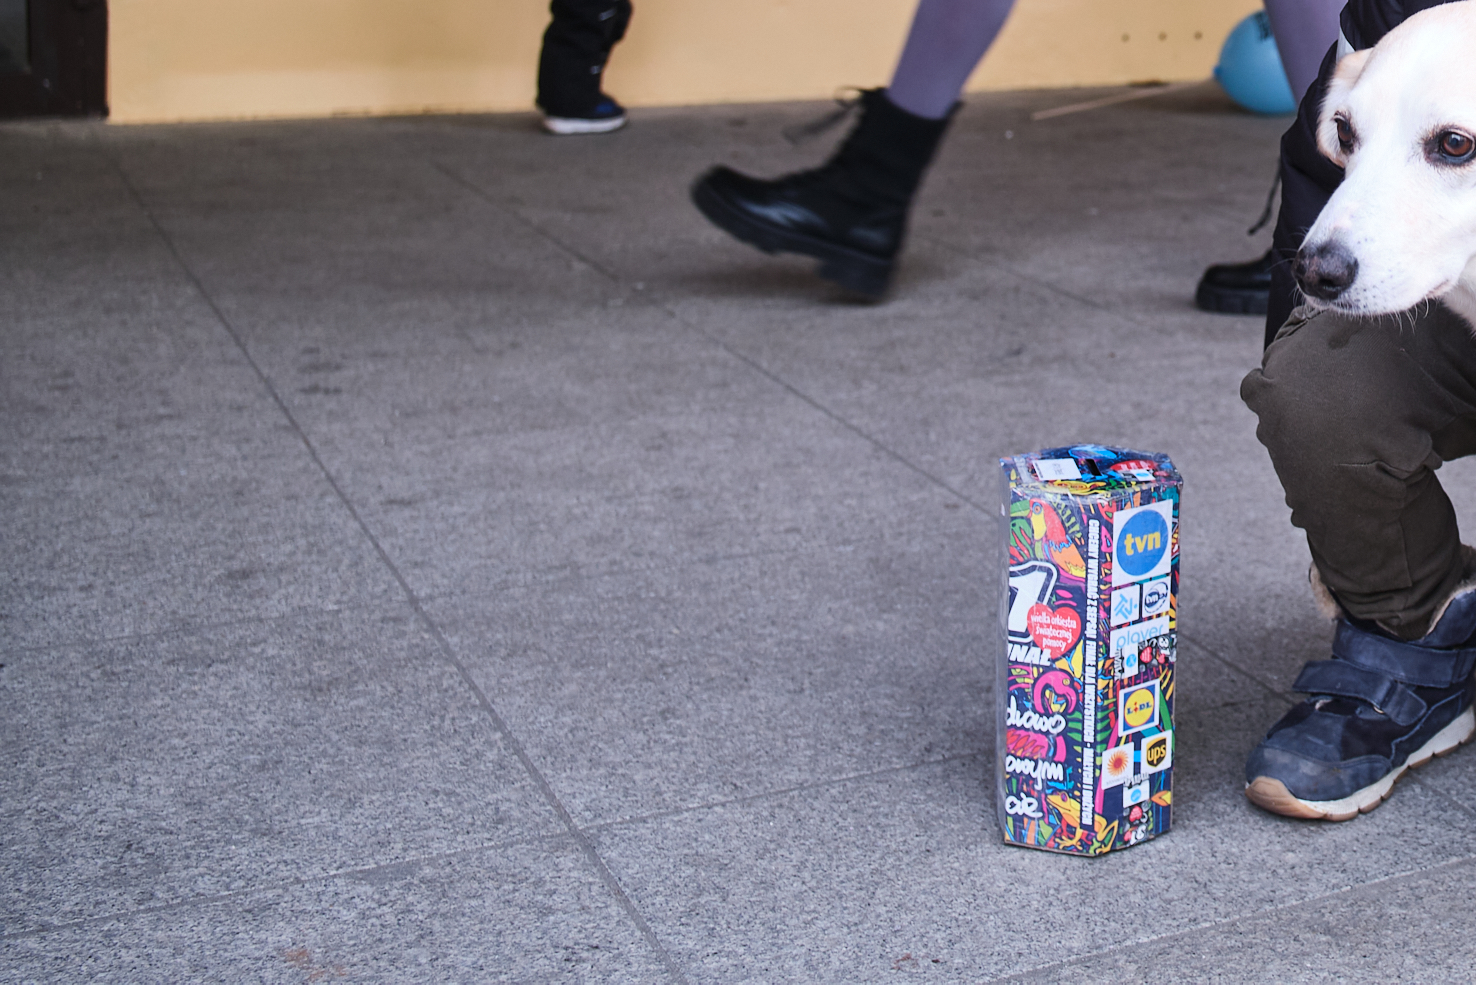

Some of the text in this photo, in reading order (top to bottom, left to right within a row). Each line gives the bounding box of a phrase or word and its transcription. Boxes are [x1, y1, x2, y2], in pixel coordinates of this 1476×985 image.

[1088, 519, 1099, 558] CHCEMY
[1124, 529, 1161, 556] tvn
[1087, 558, 1099, 599] WYGRAĆ
[1031, 611, 1077, 629] wielka orkiestra
[1035, 623, 1072, 644] świątecznej
[1043, 637, 1066, 652] pomocy
[1117, 625, 1163, 651] player
[1085, 640, 1097, 665] FINAŁ
[1085, 666, 1096, 684] DLA
[1083, 684, 1096, 742] WSZYSTKICH
[1082, 747, 1094, 784] MAŁYCH
[1147, 743, 1167, 764] ups
[1081, 790, 1094, 825] DUŻYCH
